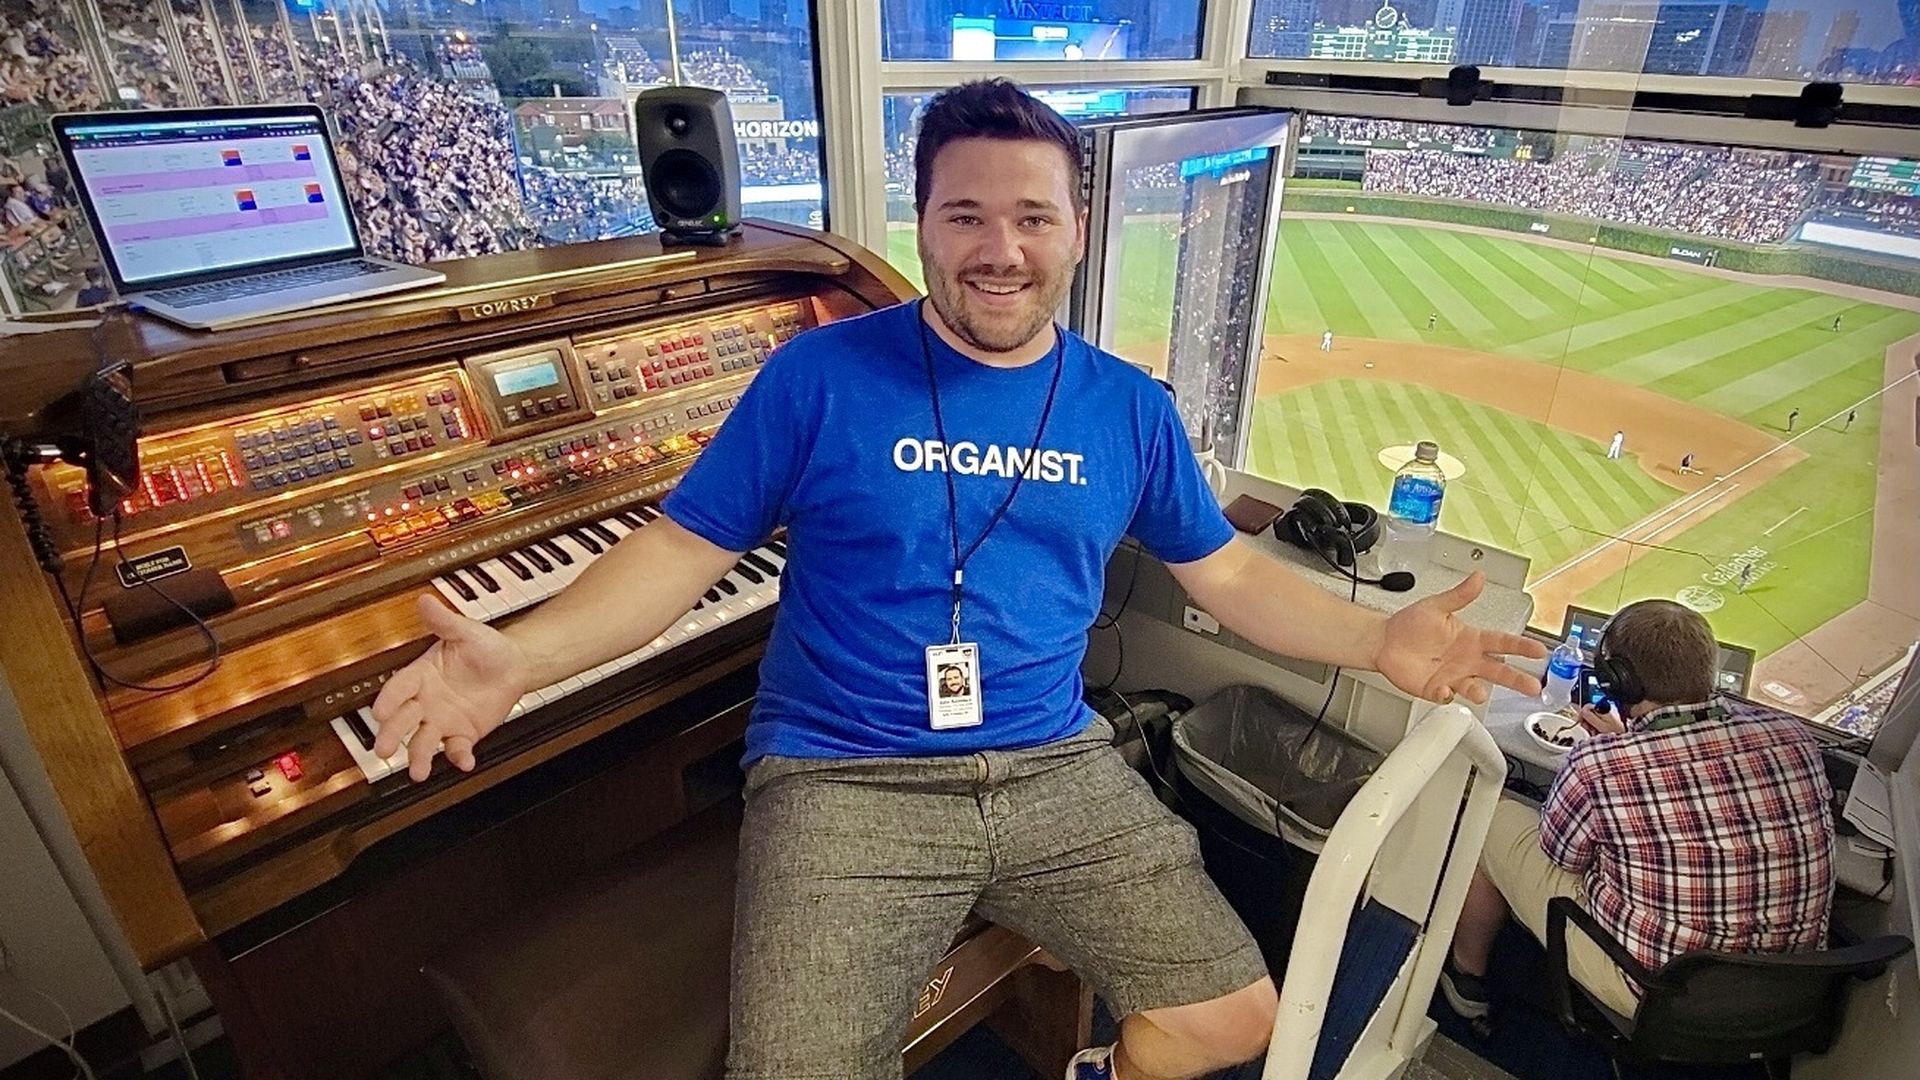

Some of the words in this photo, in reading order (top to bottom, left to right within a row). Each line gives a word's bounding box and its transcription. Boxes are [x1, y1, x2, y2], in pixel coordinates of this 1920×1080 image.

[1003, 0, 1094, 21] WINTRUST
[732, 120, 818, 138] HORIZON
[470, 294, 540, 318] LOWREY
[893, 437, 1088, 486] ORGANIST.
[1701, 545, 1768, 586] Gallagher
